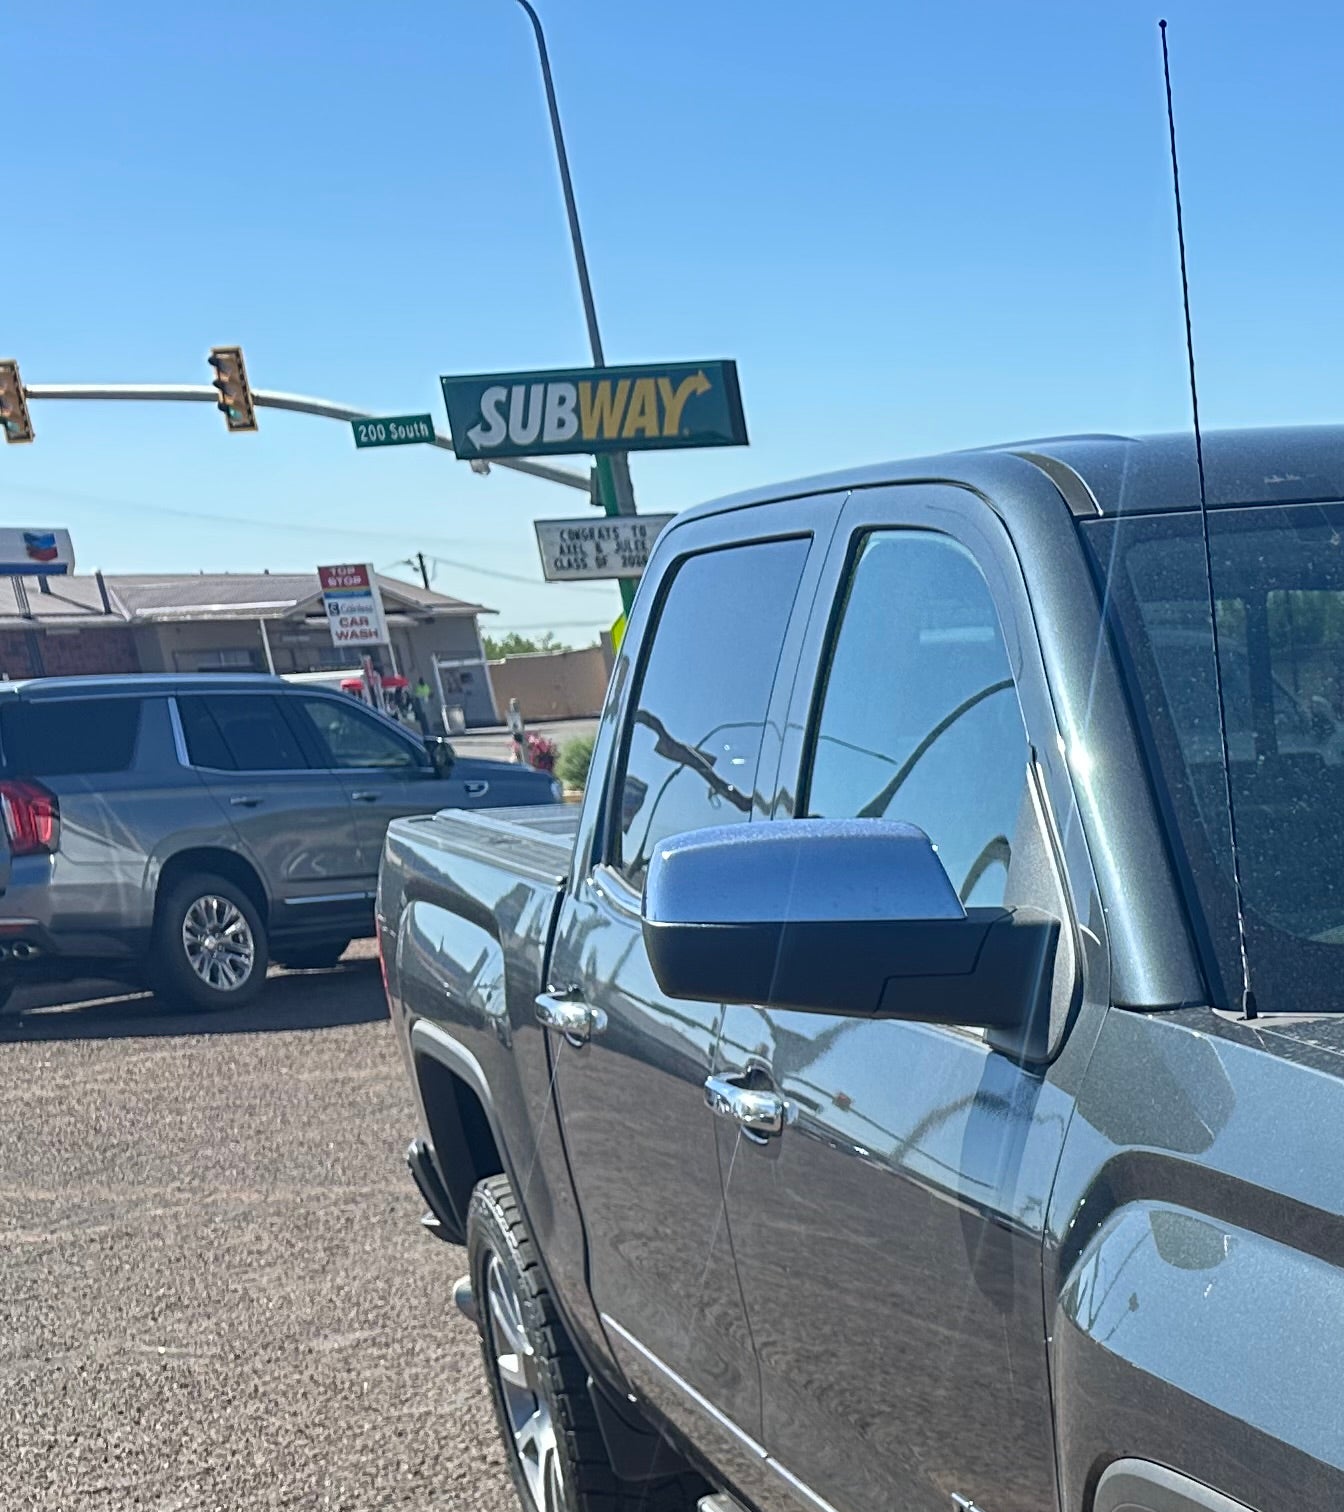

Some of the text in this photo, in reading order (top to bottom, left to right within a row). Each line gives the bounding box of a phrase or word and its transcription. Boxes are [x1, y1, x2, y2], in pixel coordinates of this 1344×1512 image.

[467, 370, 713, 452] SUBWAY
[358, 421, 429, 443] 200 South
[560, 524, 648, 542] CONGRATS TO
[553, 557, 588, 571] CLASS
[595, 555, 608, 569] OF
[328, 566, 355, 577] TOP
[327, 575, 362, 587] STOP
[339, 615, 370, 628] CAR
[335, 627, 379, 641] WASH
